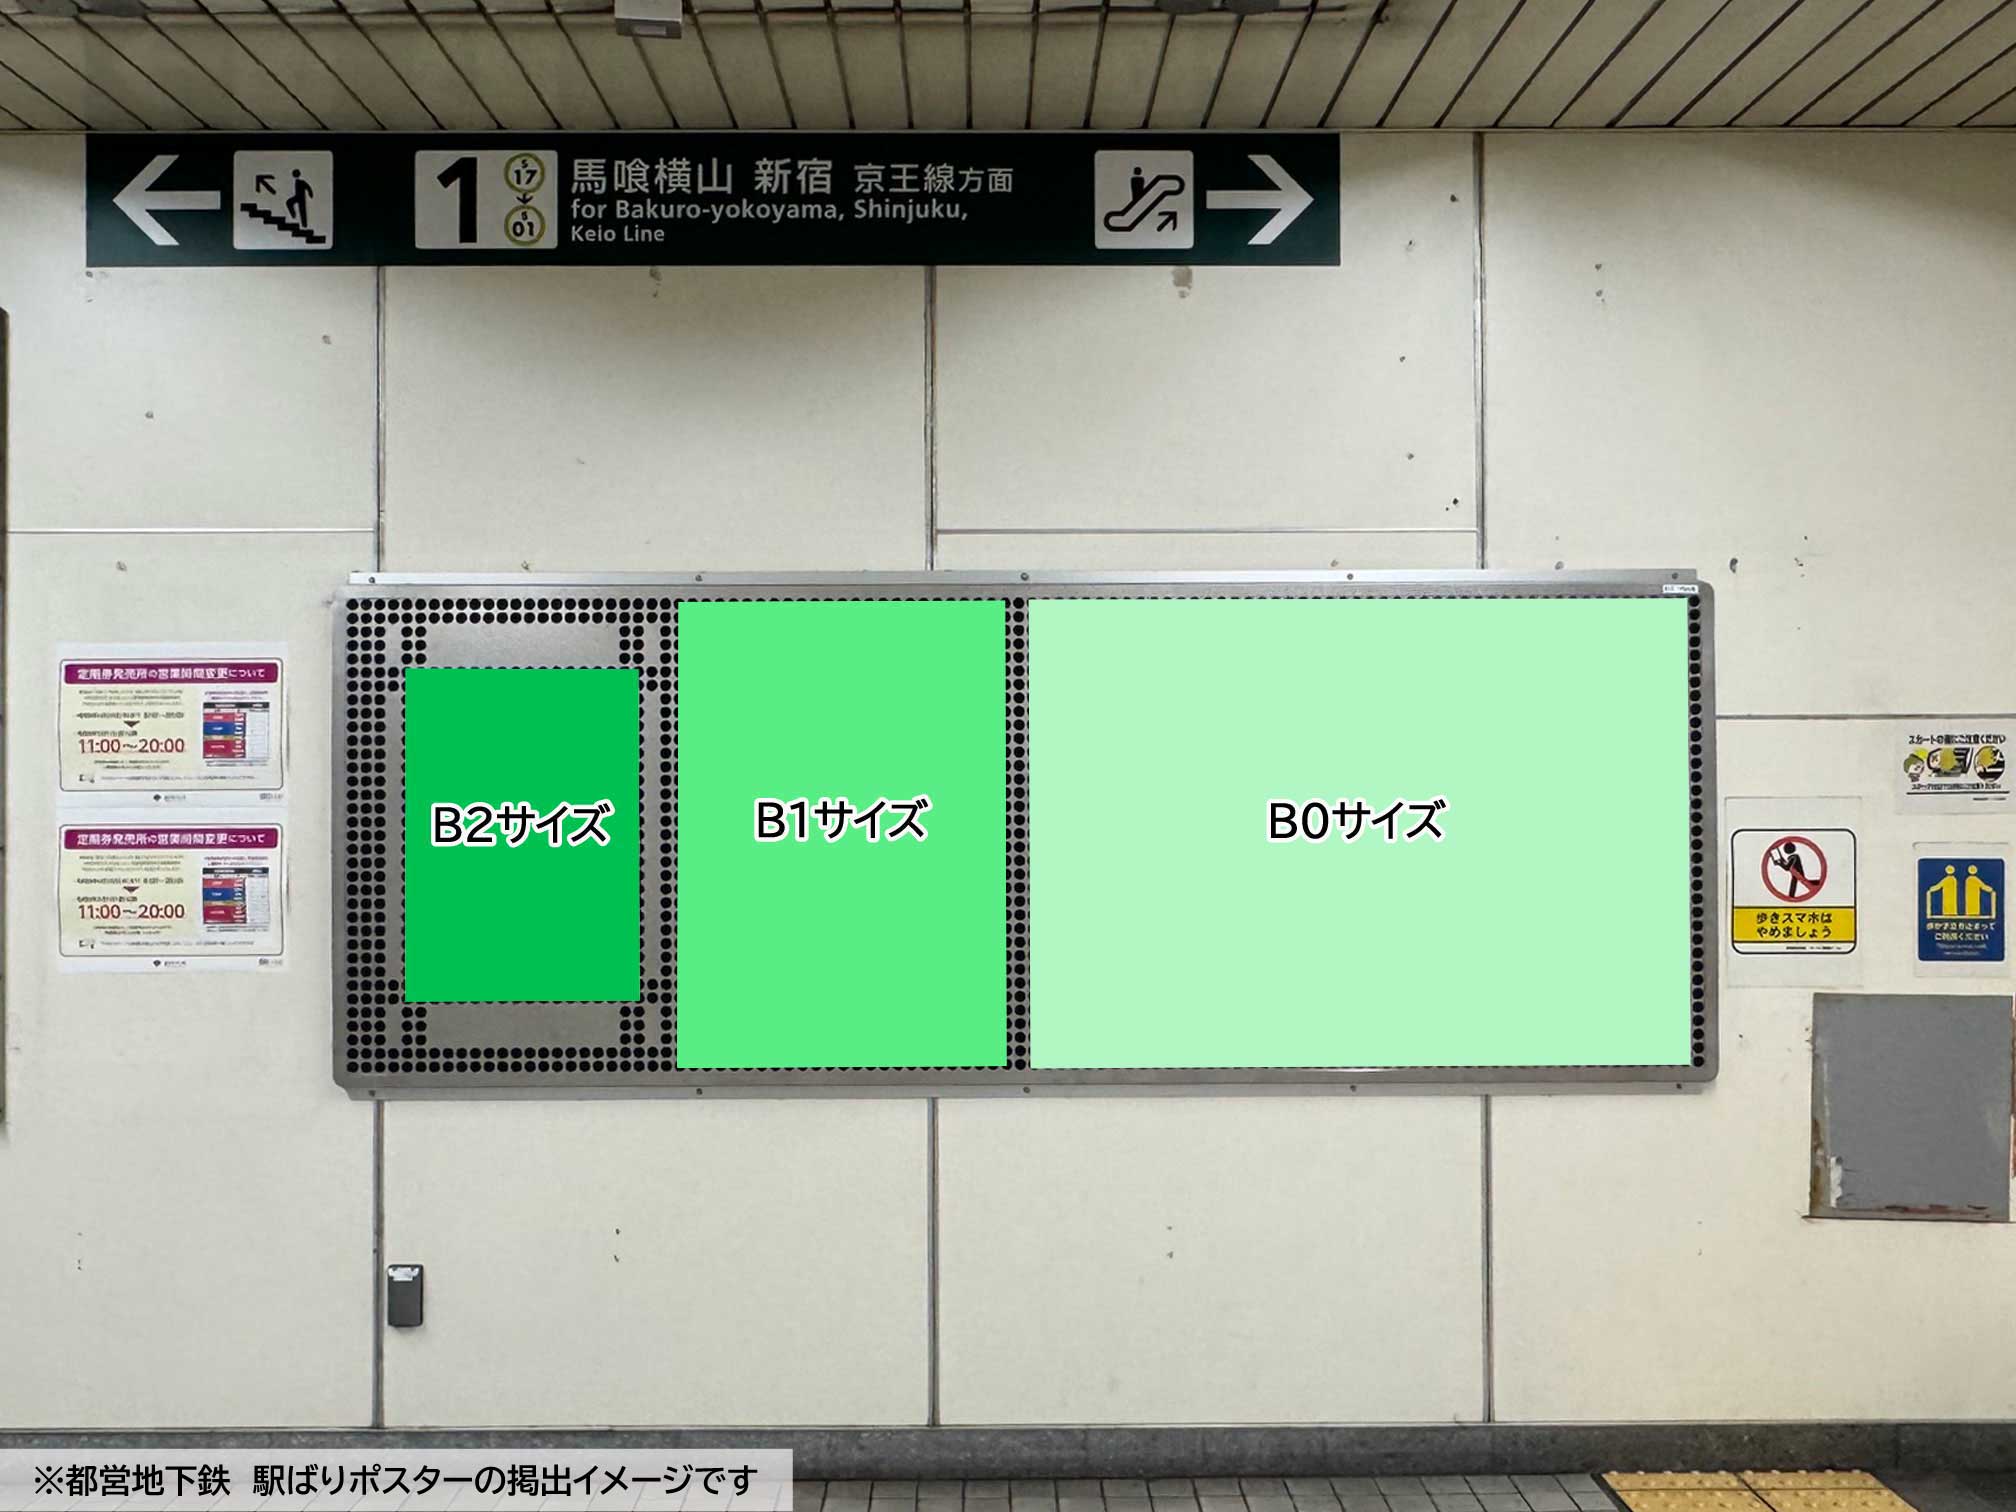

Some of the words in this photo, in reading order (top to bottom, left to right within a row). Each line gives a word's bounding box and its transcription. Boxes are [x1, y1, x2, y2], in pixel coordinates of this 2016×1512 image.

[513, 169, 537, 185] 17
[571, 157, 732, 195] 馬喰横山
[754, 157, 832, 195] 新宿
[854, 162, 1014, 194] 京王線方面
[436, 156, 478, 243] 1
[571, 199, 607, 219] for
[615, 198, 845, 224] Bakuro-yokoyama,
[854, 198, 968, 224] Shinjuku,
[512, 221, 535, 237] 01
[571, 225, 616, 242] Keio
[624, 225, 665, 242] Line
[1756, 912, 1833, 924] 歩きスマホは
[1756, 926, 1832, 938] やめましょう
